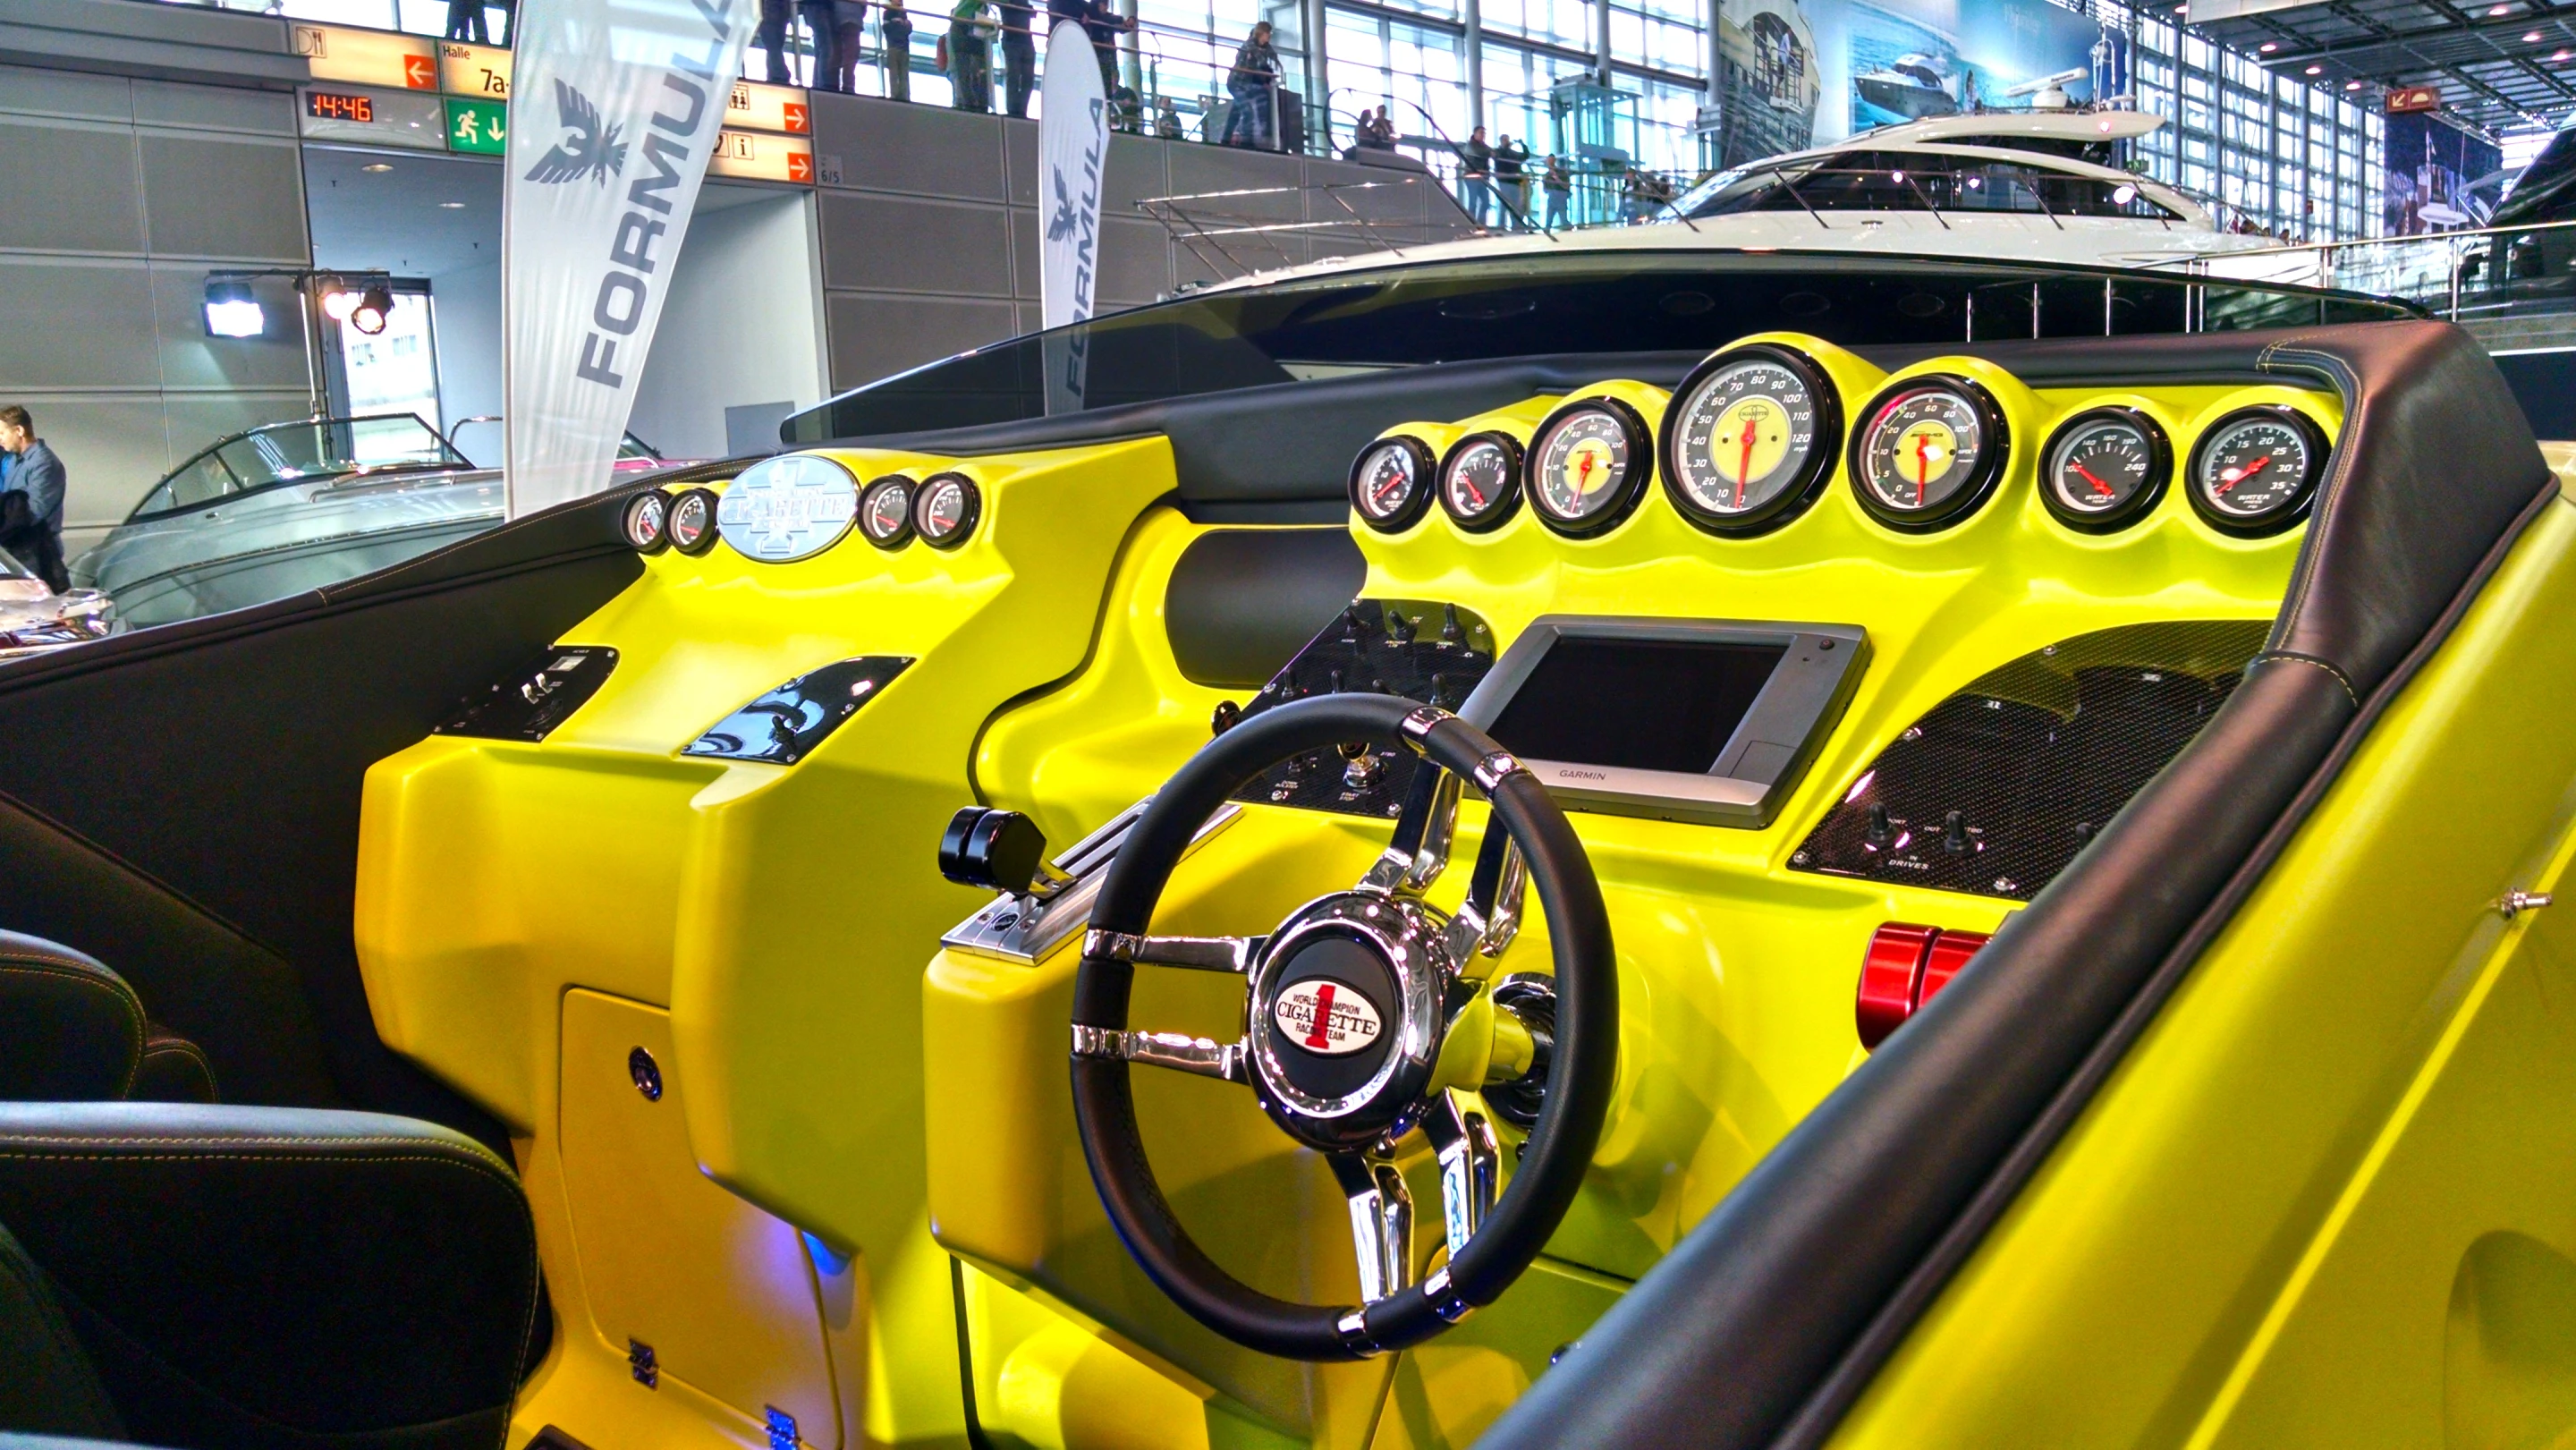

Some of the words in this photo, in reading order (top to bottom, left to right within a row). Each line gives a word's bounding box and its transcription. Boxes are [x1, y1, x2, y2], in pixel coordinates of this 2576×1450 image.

[443, 46, 471, 60] Halle
[480, 68, 509, 94] 7a
[315, 94, 372, 122] 14:46
[820, 170, 840, 183] 6/5
[575, 0, 733, 390] FORMULA
[1065, 98, 1104, 397] FORMULA
[1750, 376, 1767, 385] 80
[1770, 380, 1786, 390] 90
[1730, 383, 1744, 391] 70
[1711, 396, 1726, 406] 60
[1783, 394, 1802, 403] 100
[1698, 415, 1713, 424] 50
[1792, 411, 1809, 421] 110
[1691, 437, 1707, 445] 40
[1792, 434, 1811, 443] 120
[2258, 437, 2275, 445] 20
[2237, 440, 2250, 449] 15
[2272, 447, 2288, 455] 25
[1693, 459, 1707, 468] 30
[2224, 455, 2238, 464] 10
[2124, 463, 2147, 471] 240
[2276, 464, 2293, 472] 30
[1702, 477, 1716, 486] 20
[2269, 481, 2286, 489] 35
[1895, 484, 1902, 492] 0
[1716, 488, 1730, 498] 10
[1559, 769, 1606, 780] GARMIN
[1888, 859, 1929, 870] DRIVES
[1292, 993, 1318, 1006] WORLD
[1276, 1001, 1377, 1036] CIGARETTE
[1324, 1028, 1346, 1042] TEAM
